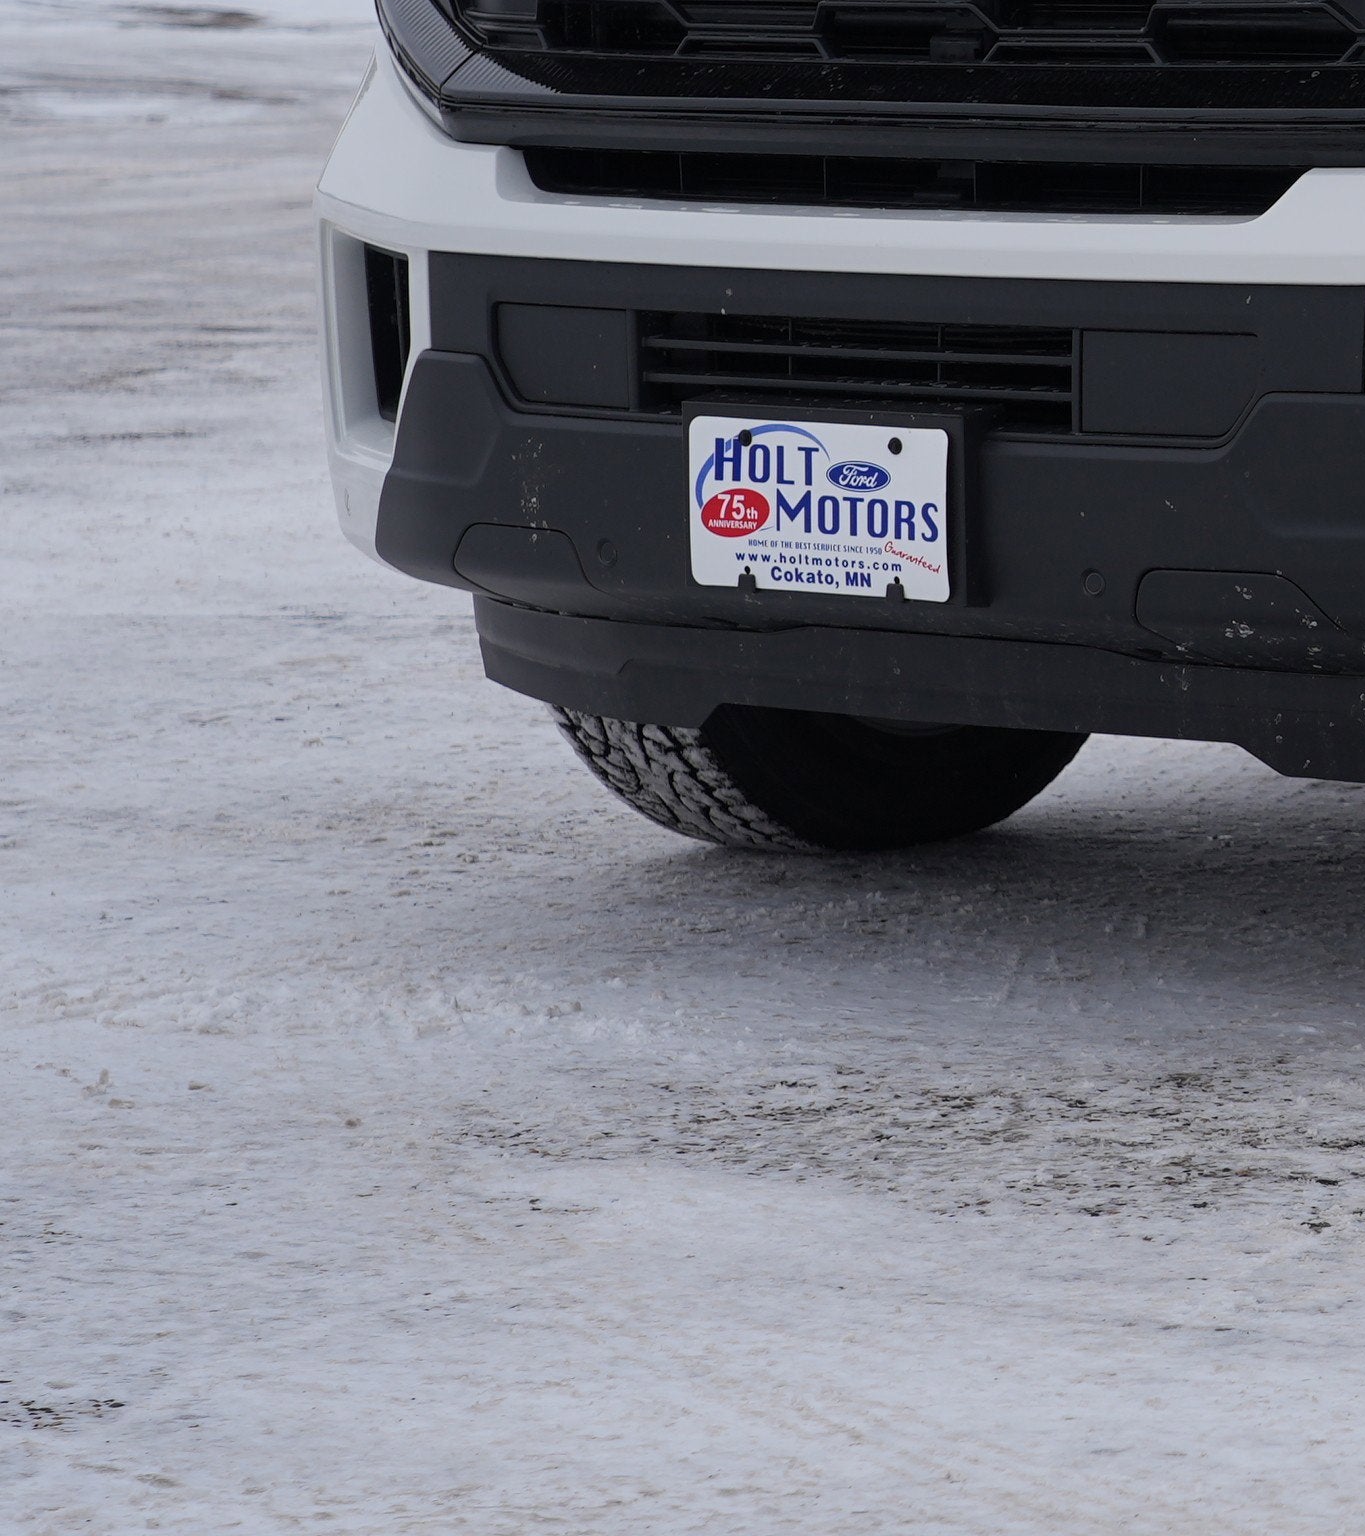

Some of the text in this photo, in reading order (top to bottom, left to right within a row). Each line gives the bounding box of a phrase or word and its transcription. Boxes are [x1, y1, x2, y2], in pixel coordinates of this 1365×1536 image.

[714, 438, 820, 486] HOLT
[839, 464, 879, 488] Ford
[717, 493, 758, 520] 75th
[776, 488, 939, 543] MOTORS
[708, 518, 758, 530] ANNIVERSARY
[748, 539, 883, 556] HOME OF THE BEST SERVICE SINCE 1950
[884, 540, 941, 574] Guaranteed
[735, 552, 902, 572] www.holtmotors.com
[771, 566, 872, 588] Cokato, MN
